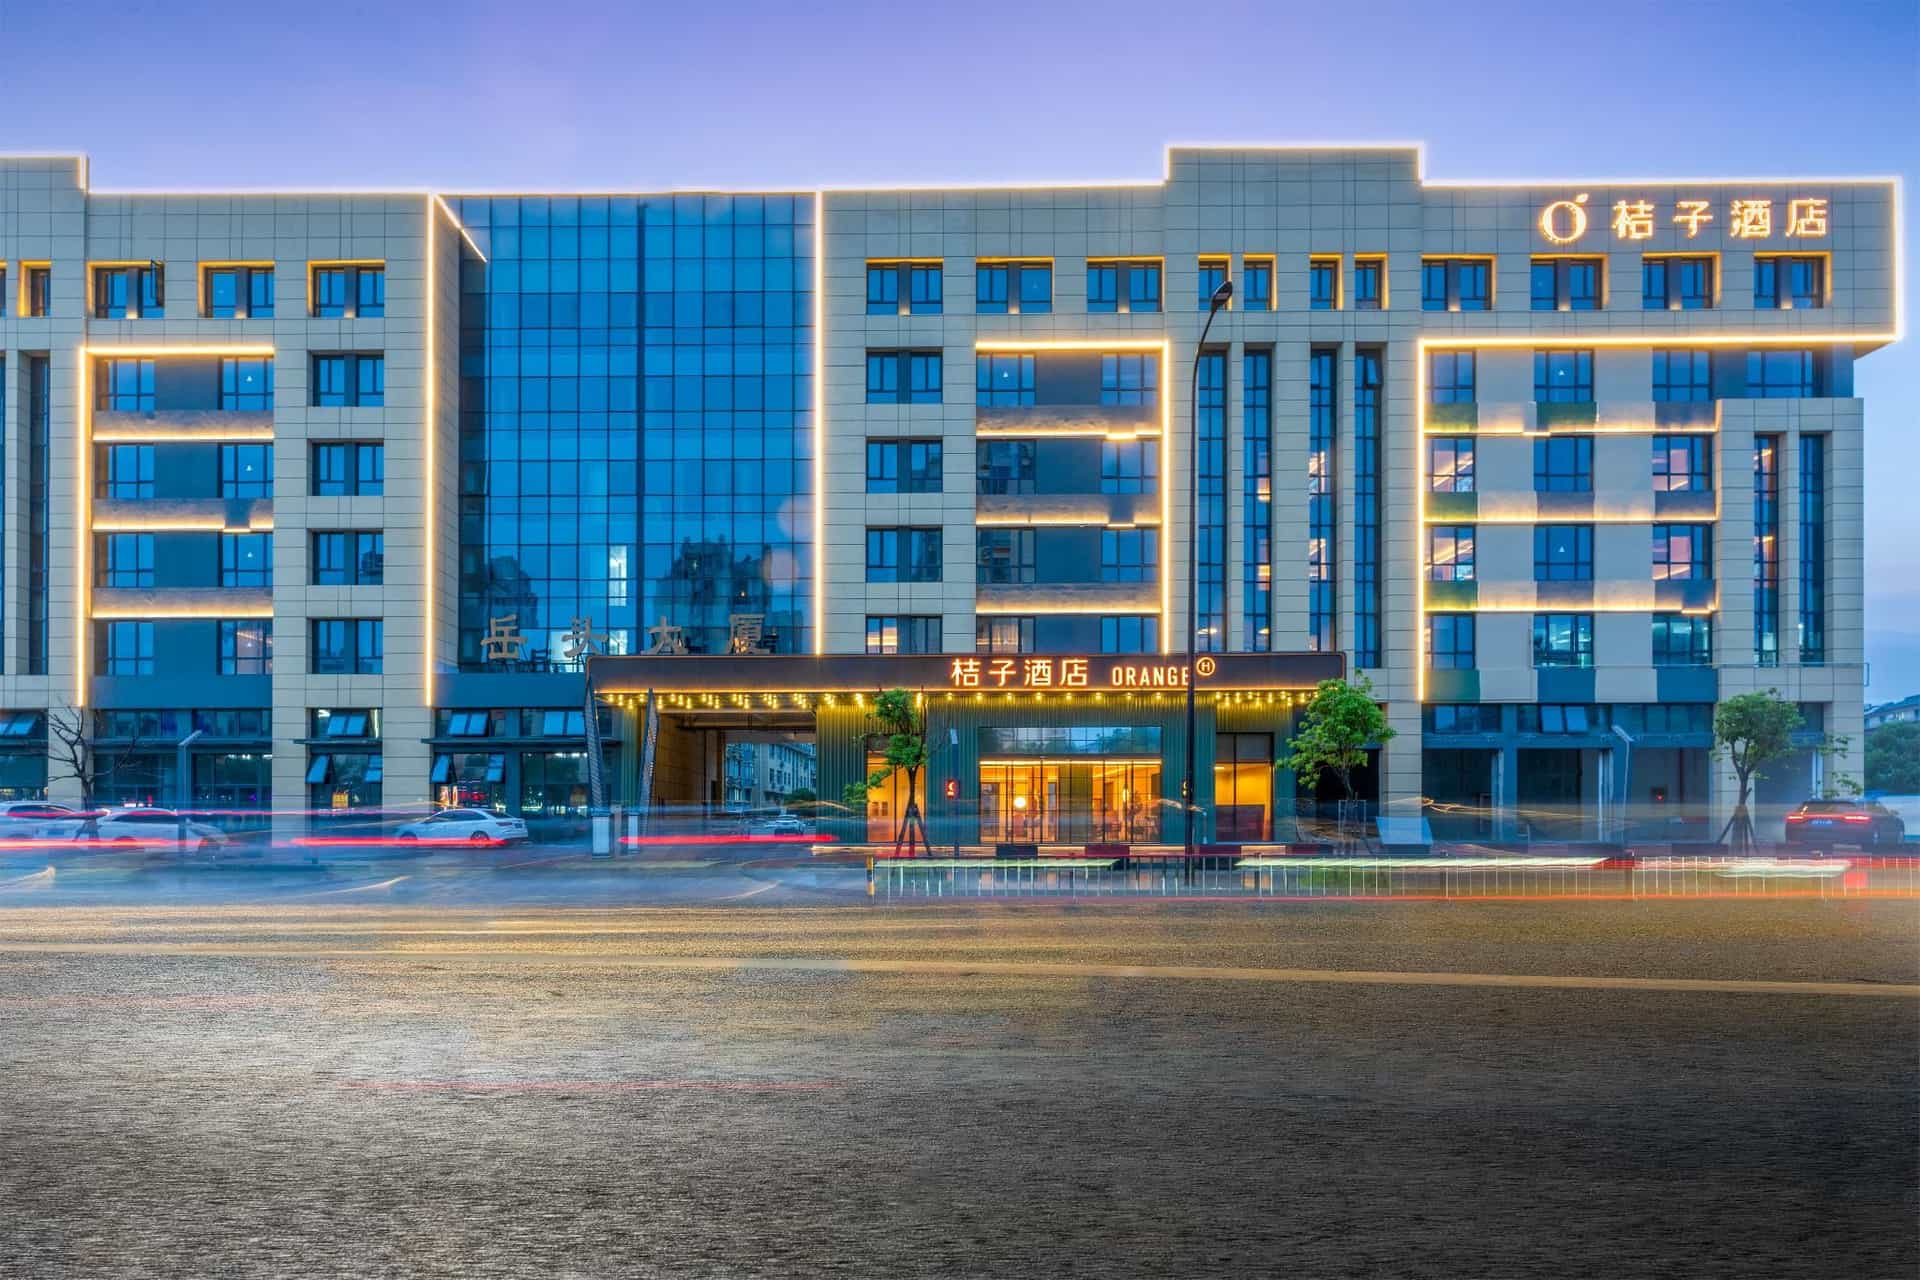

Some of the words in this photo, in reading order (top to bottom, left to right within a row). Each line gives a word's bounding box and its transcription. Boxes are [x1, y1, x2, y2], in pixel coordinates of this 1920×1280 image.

[1612, 199, 1828, 239] 桔子酒店
[951, 658, 1089, 687] 桔子酒店
[1111, 666, 1189, 687] ORANGE
